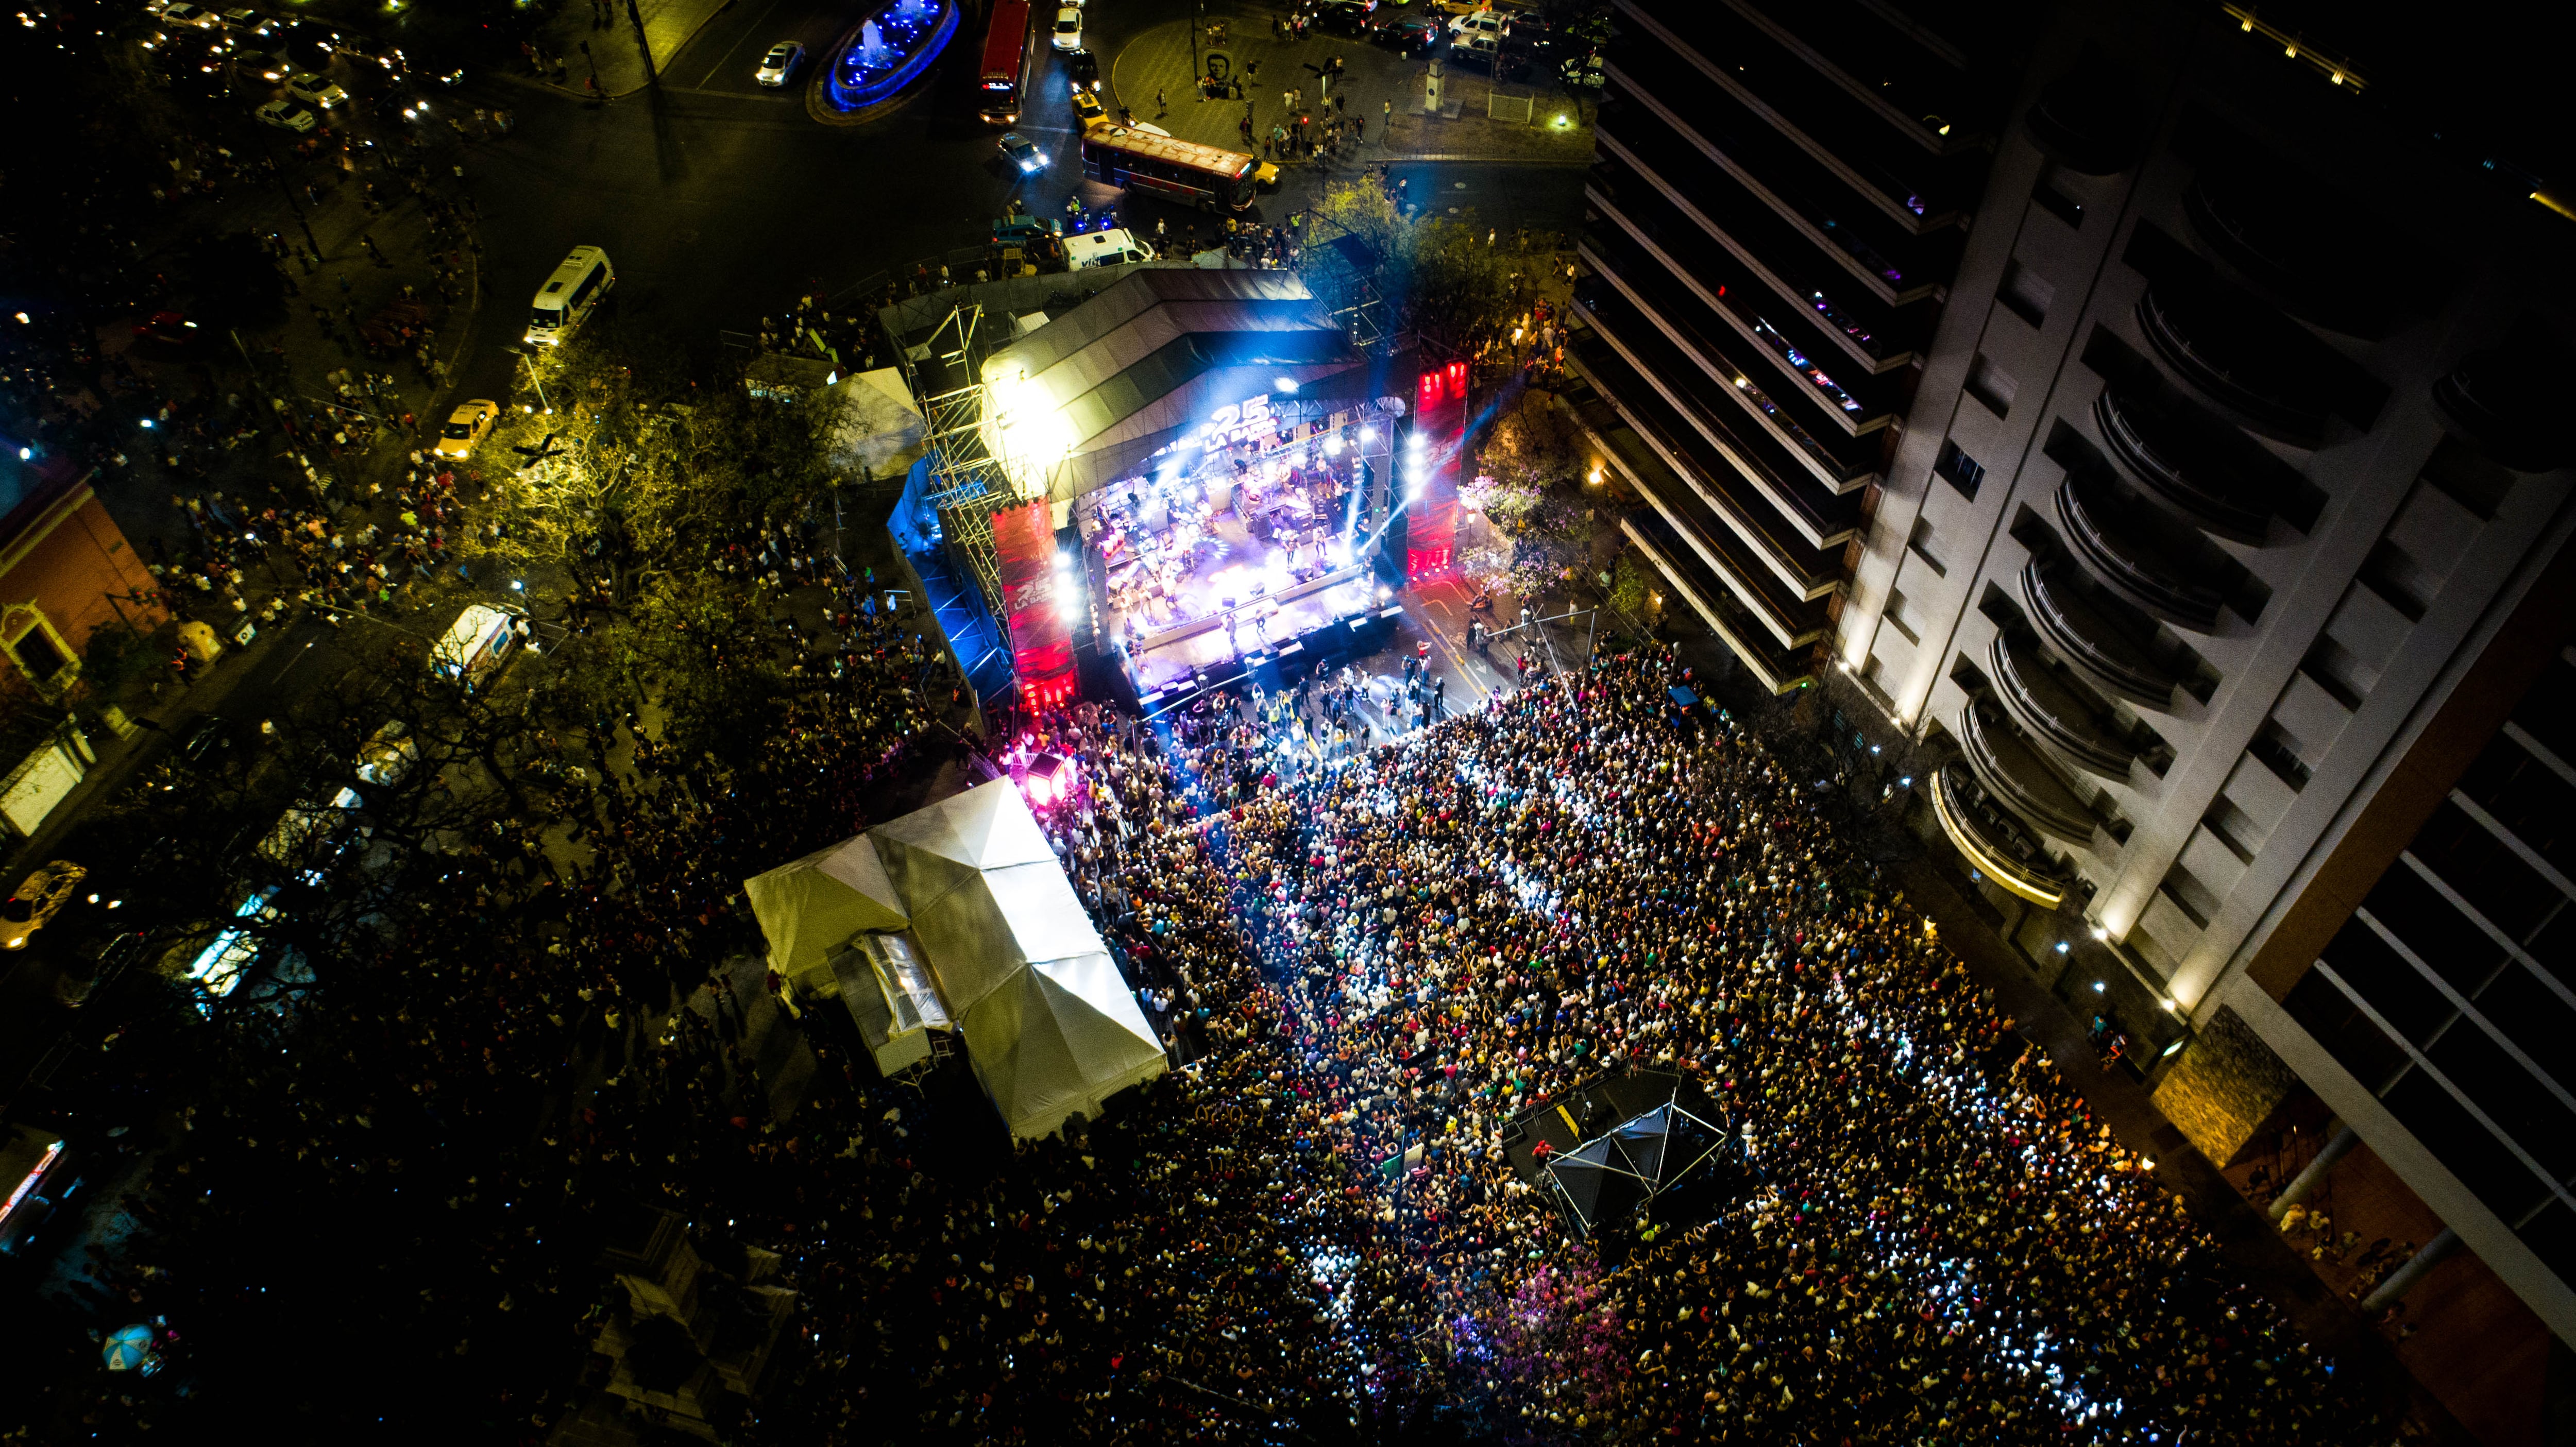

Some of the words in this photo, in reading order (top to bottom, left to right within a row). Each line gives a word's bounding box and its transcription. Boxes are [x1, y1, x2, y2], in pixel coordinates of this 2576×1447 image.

[1211, 394, 1270, 441] 25
[1205, 434, 1227, 452] LA
[1016, 576, 1052, 603] 25
[1014, 600, 1028, 610] LA
